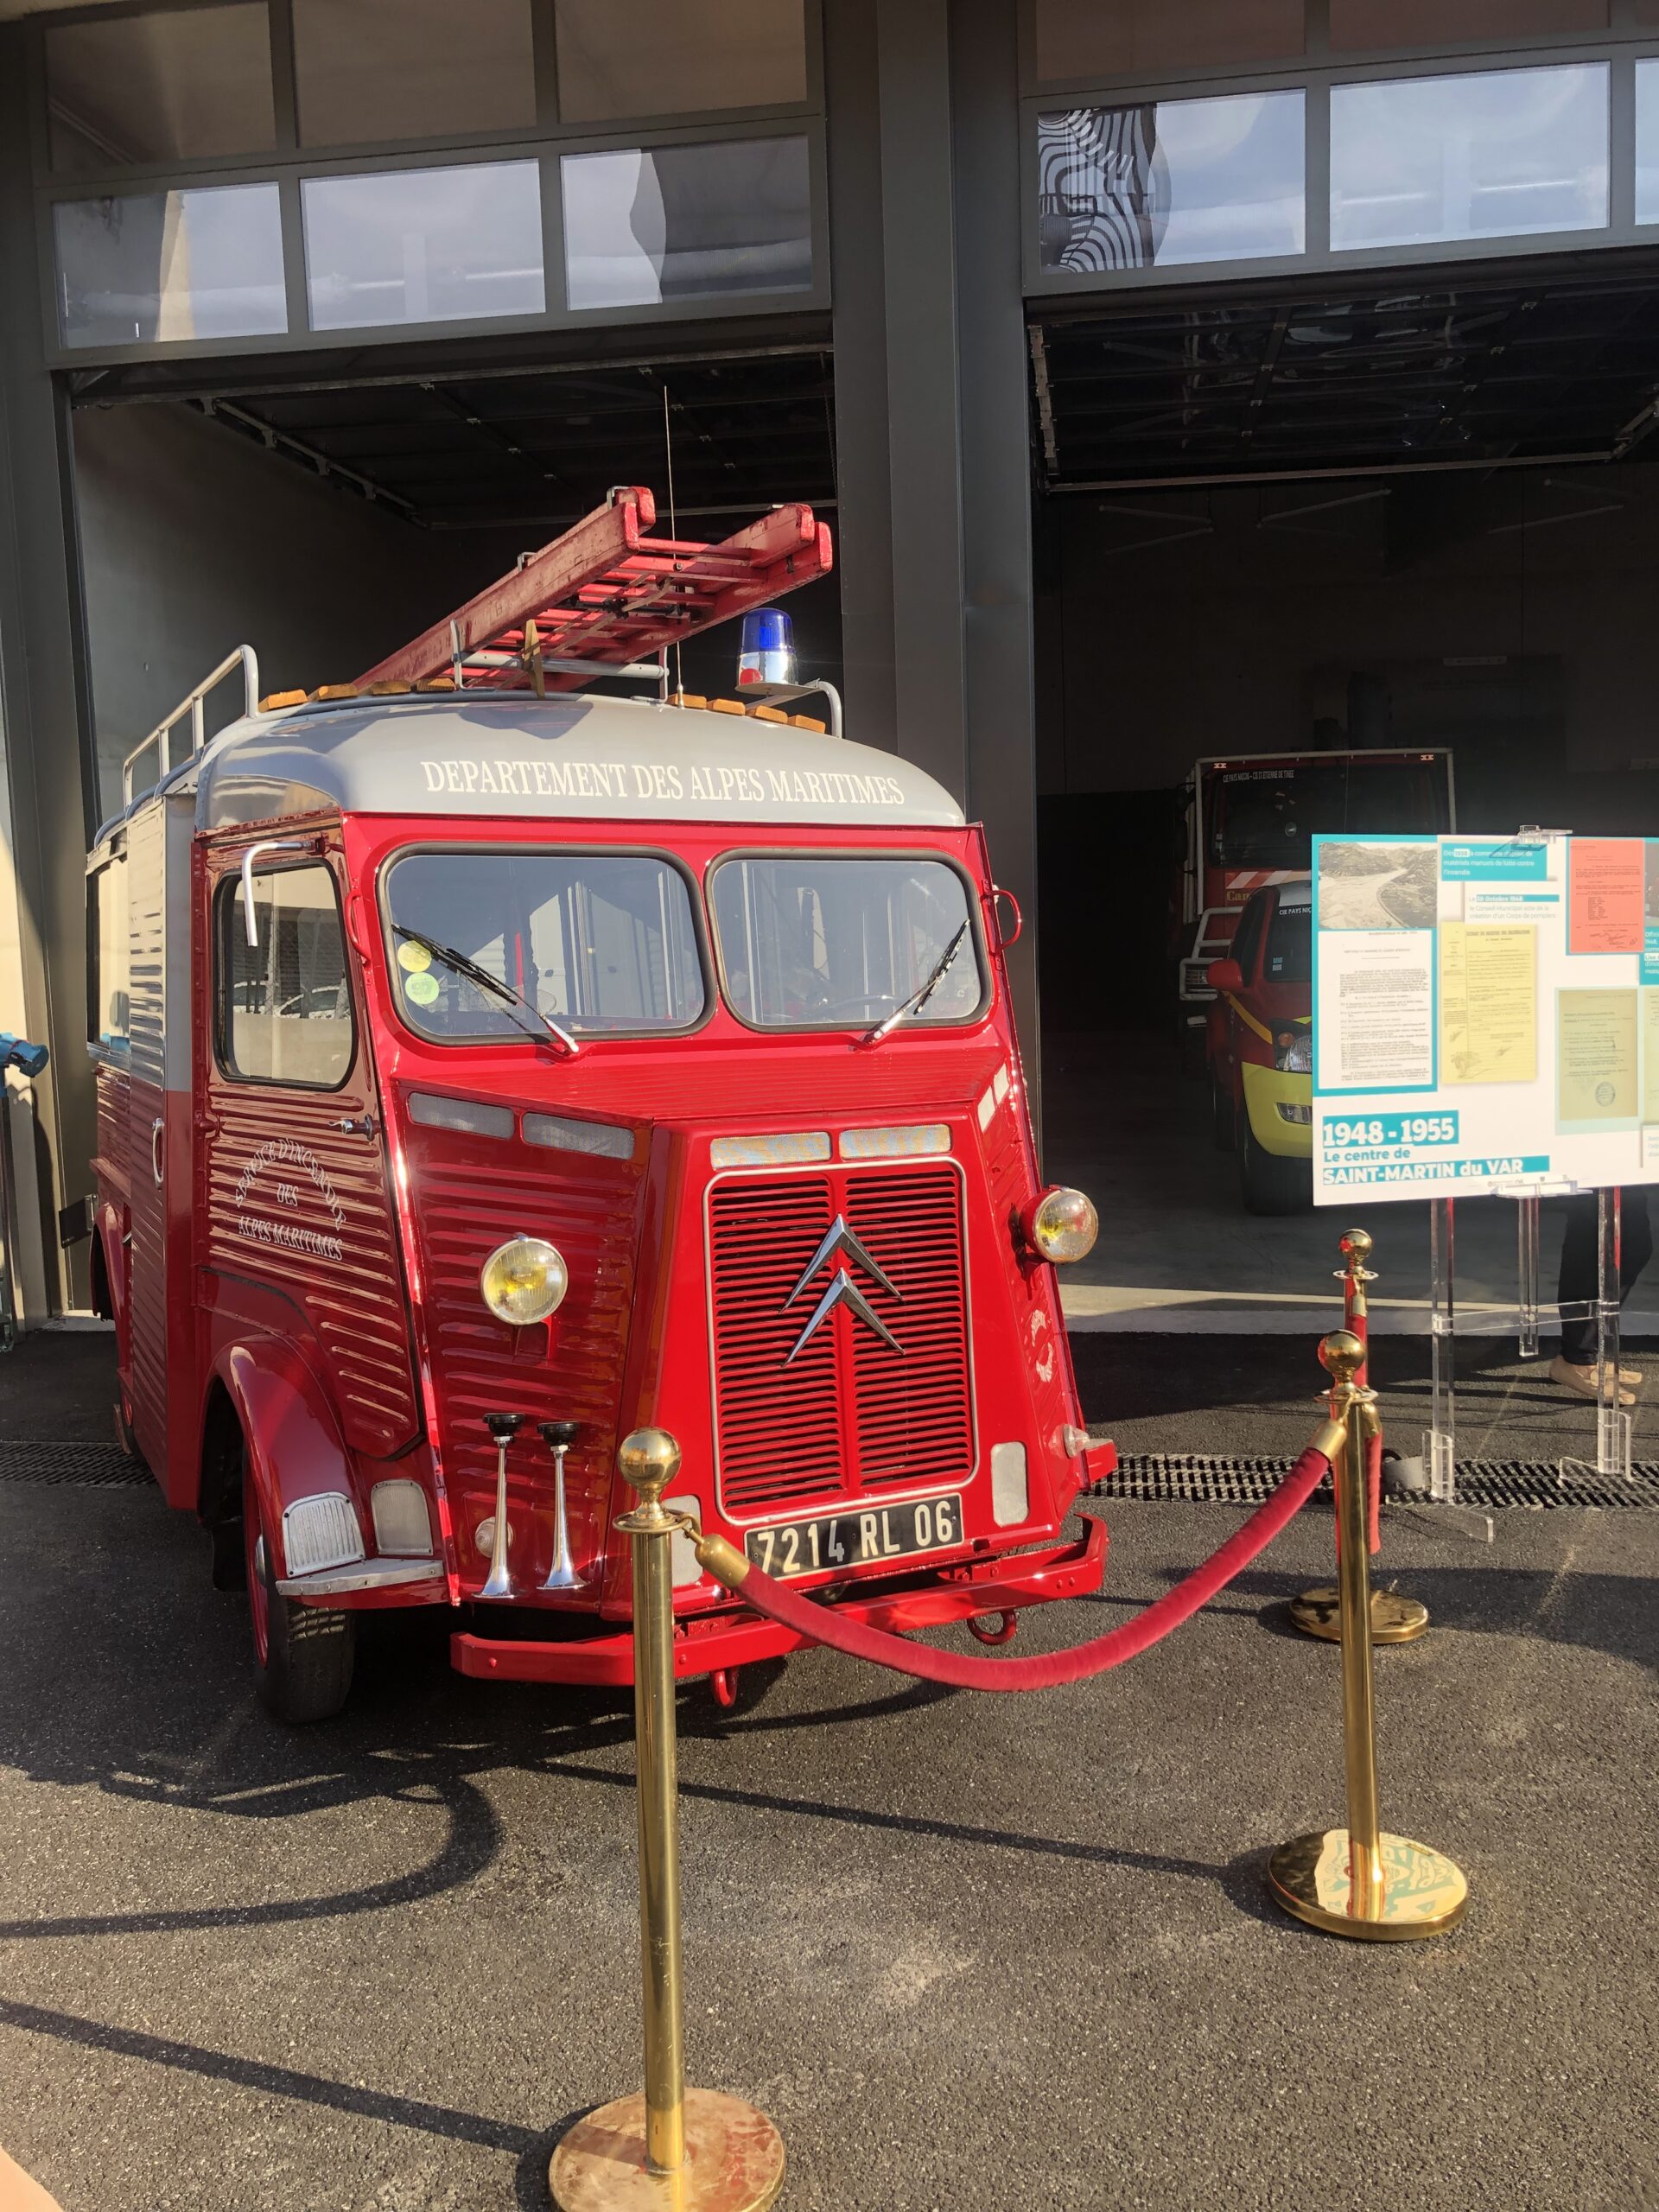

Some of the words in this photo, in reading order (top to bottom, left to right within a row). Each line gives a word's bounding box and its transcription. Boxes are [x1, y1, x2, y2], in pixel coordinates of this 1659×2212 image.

[421, 760, 627, 798] DEPARTEMENT
[632, 765, 684, 800] DES
[690, 766, 765, 803] ALPES
[765, 768, 905, 805] MARITIMES
[1323, 1121, 1384, 1147] 1948
[1400, 1117, 1455, 1143] 1955
[1322, 1161, 1455, 1185] SAINT-MARTIN
[1459, 1160, 1482, 1177] du
[1485, 1158, 1524, 1175] VAR
[1324, 1151, 1340, 1162] Le
[1344, 1149, 1389, 1161] centre
[1393, 1147, 1411, 1160] de
[235, 1141, 276, 1209] SERVICE
[277, 1138, 346, 1231] D'INCENDIE
[276, 1182, 299, 1207] DES
[238, 1215, 272, 1243] ALPES
[272, 1223, 343, 1262] MARITIMES
[757, 1519, 845, 1573] 7214
[860, 1510, 900, 1559] RL
[914, 1500, 953, 1547] 06
